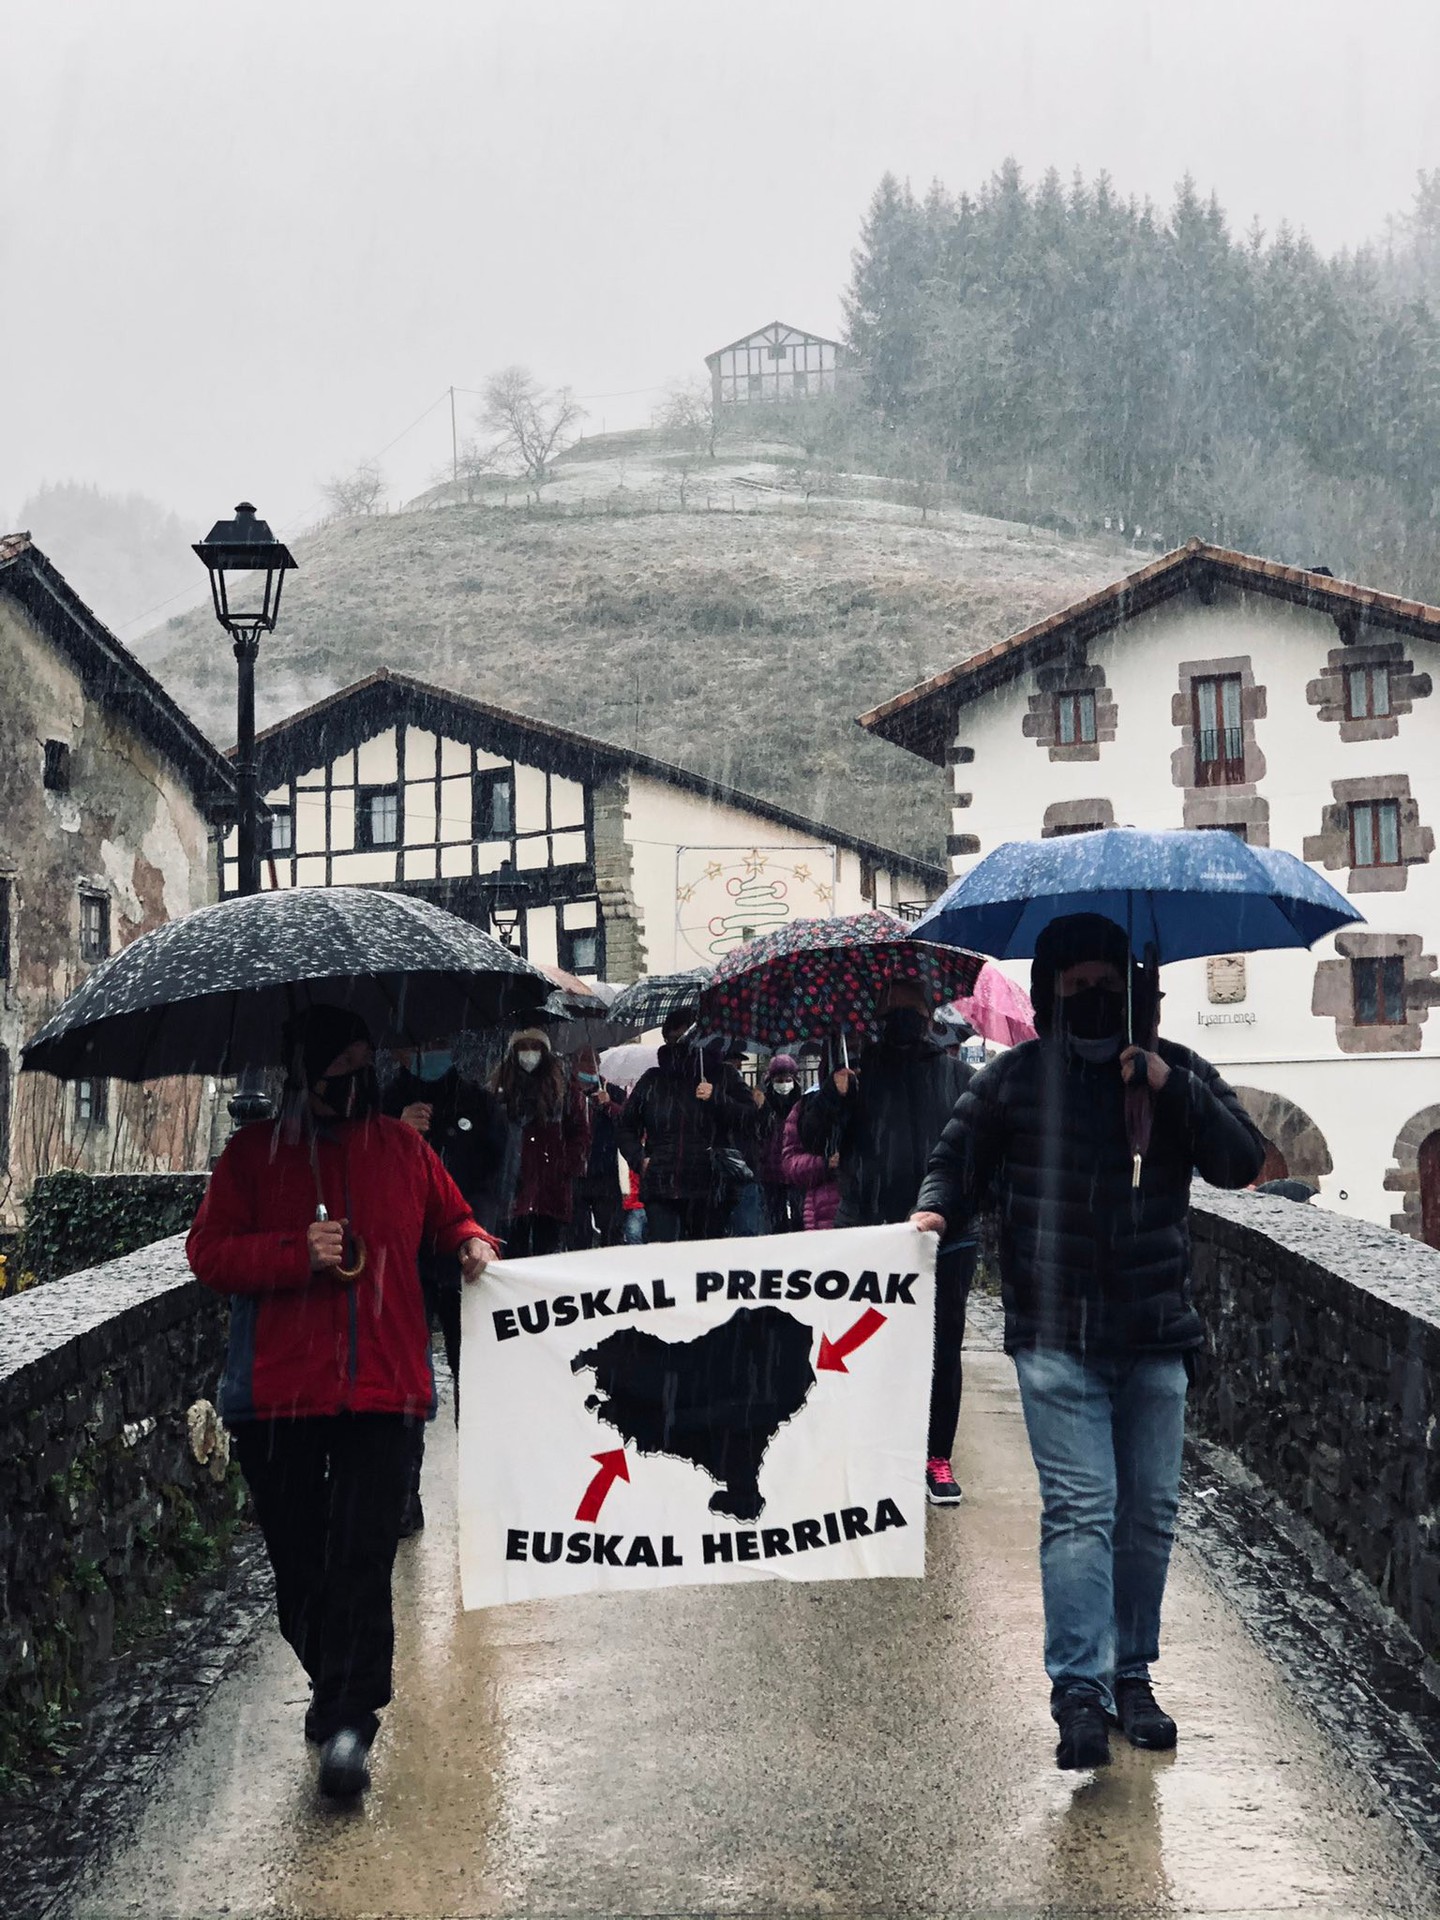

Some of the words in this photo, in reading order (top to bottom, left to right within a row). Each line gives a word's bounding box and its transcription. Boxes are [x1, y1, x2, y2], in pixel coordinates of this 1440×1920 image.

[492, 1279, 676, 1341] EUSKAL
[696, 1269, 920, 1304] PRESOAK
[505, 1528, 683, 1567] EUSKAL
[702, 1498, 908, 1565] HERRIRA
